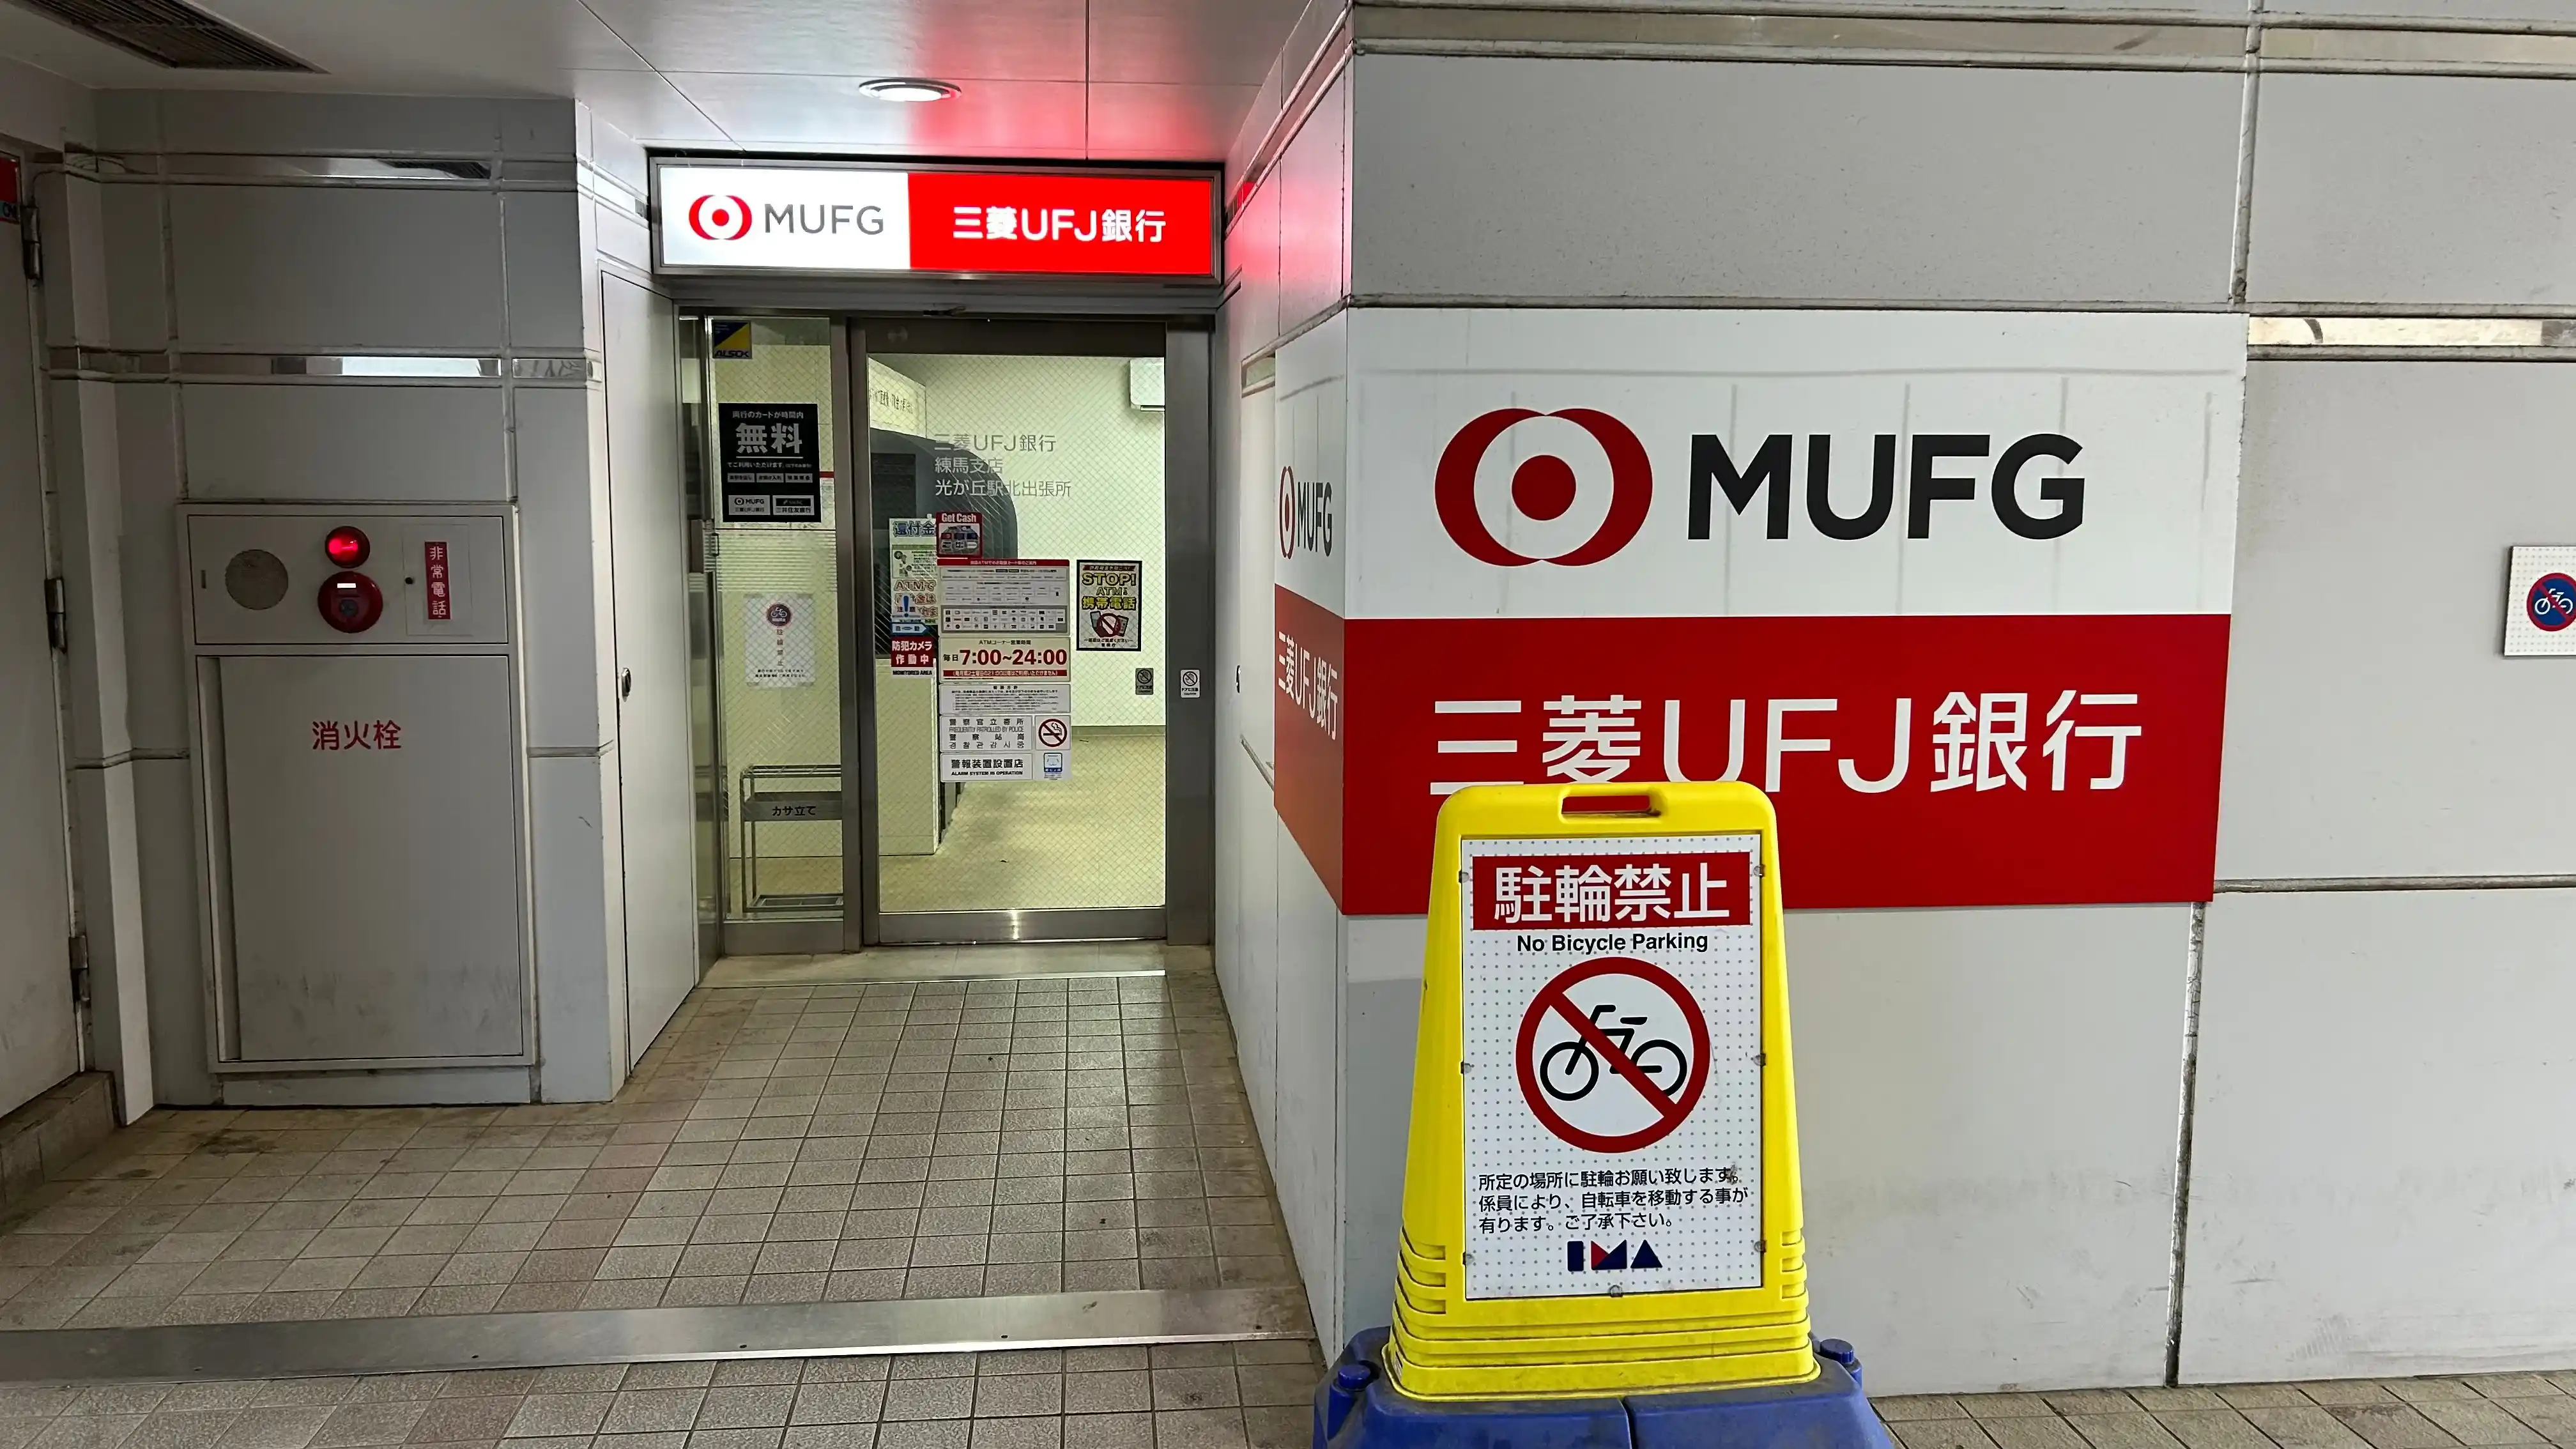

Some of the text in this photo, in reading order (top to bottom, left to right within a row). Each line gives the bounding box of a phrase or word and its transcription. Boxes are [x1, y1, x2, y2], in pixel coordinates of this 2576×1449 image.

[765, 203, 884, 236] MUFG
[953, 206, 1167, 243] 三菱UFJ銀行
[714, 349, 749, 358] ALSOK
[735, 422, 803, 454] 無料
[933, 433, 1057, 452] 三菱UFJ銀行
[935, 457, 1004, 474] 練馬支店
[935, 480, 1071, 497] 光が丘駅北出張所
[1689, 432, 2085, 540] MUFG
[942, 512, 977, 523] Get Cash
[1296, 480, 1333, 558] MUFG
[429, 546, 447, 617] 非常電話
[1082, 572, 1137, 586] STOP!
[1082, 595, 1137, 610] 携帯電話
[891, 640, 933, 652] 防犯カメラ
[895, 654, 929, 665] 作動中
[942, 654, 959, 662] 毎日
[1278, 631, 1339, 741] 三菱UFJ銀行
[949, 718, 1024, 726] 警察官立寄所
[312, 719, 402, 751] 消火栓
[1430, 689, 2142, 794] 三菱UFJ銀行
[951, 759, 1024, 769] 警報装置設置店
[772, 806, 816, 816] カサ立て
[1494, 862, 1729, 924] 駐輪禁止
[1517, 931, 1708, 955] No Bicycle Parking
[1478, 1166, 1740, 1190] 所定の場所に駐輪お願い致します。
[1478, 1186, 1749, 1213] 係員により、自転車を移動する事が
[1478, 1211, 1673, 1234] 有ります。ご了承下さい。
[1567, 1239, 1663, 1271] IMA
